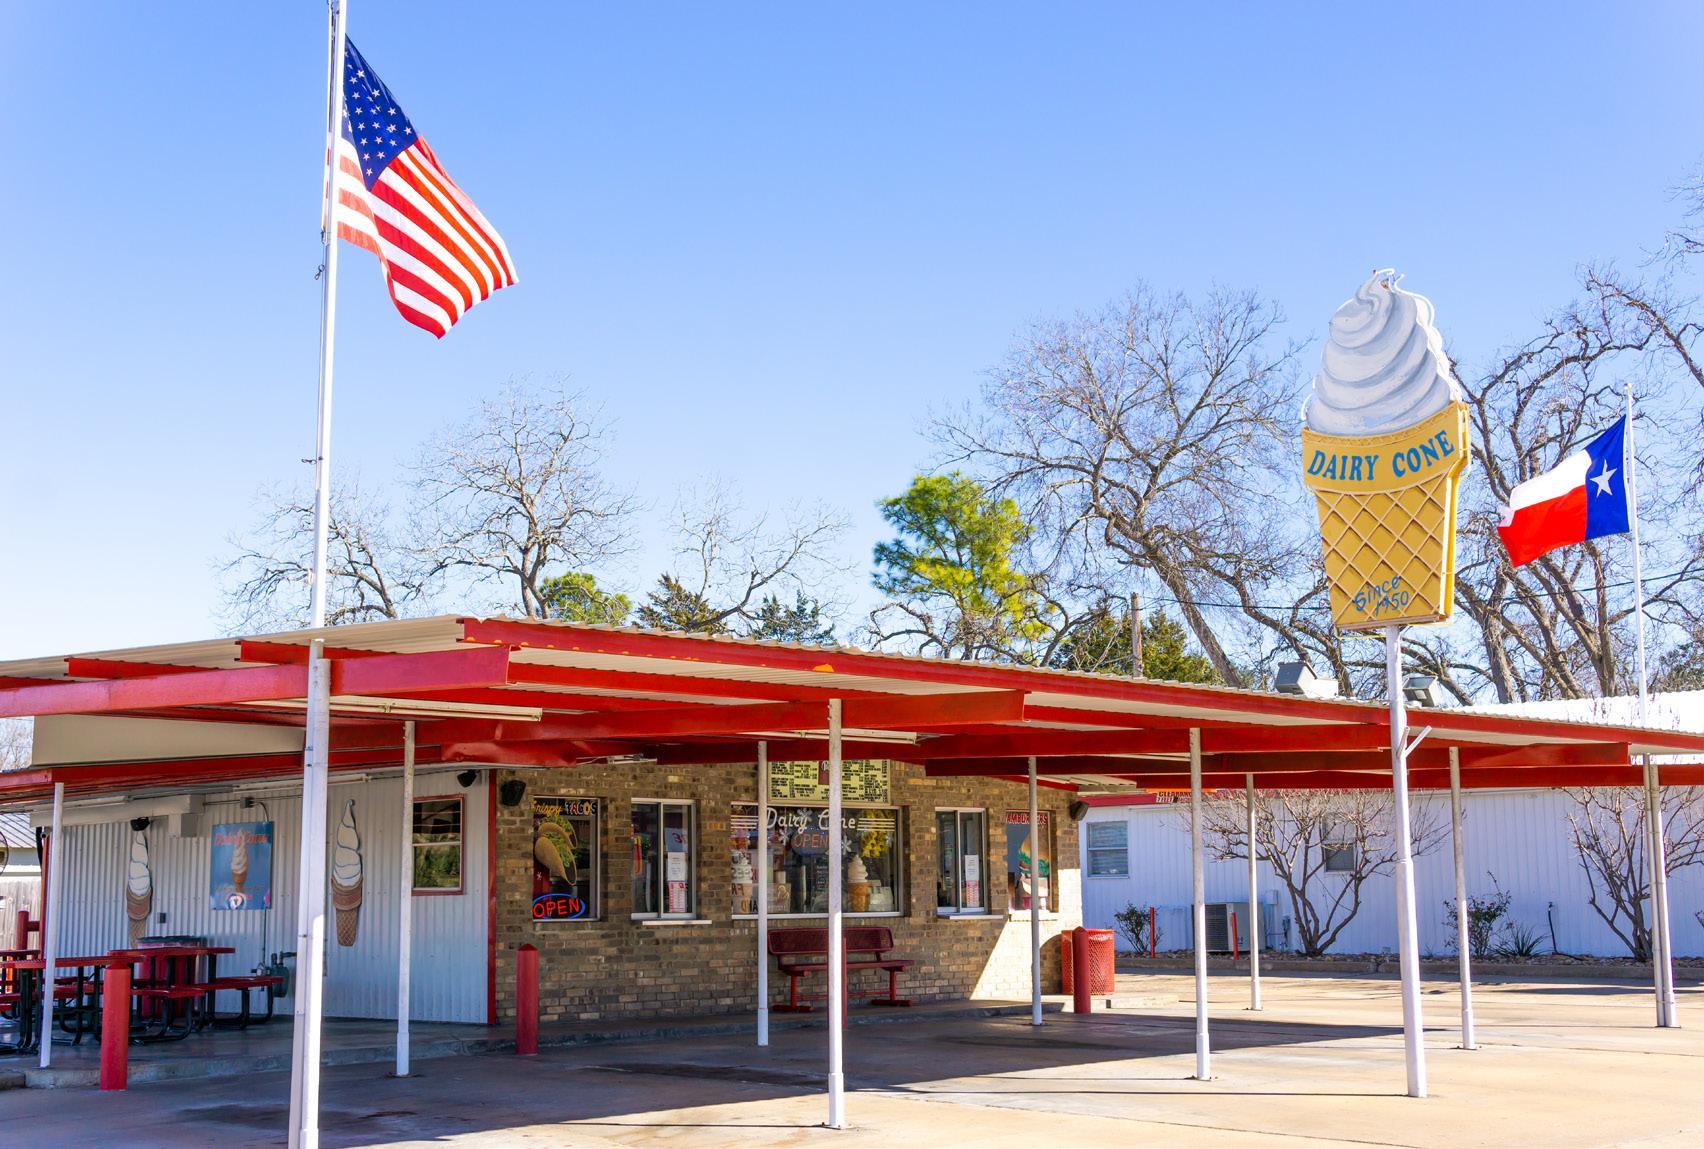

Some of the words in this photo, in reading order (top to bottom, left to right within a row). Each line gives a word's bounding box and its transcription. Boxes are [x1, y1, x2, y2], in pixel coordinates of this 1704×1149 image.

[1307, 450, 1379, 481] DAIRY
[1392, 430, 1455, 478] CONE
[1354, 576, 1400, 612] Since
[1375, 590, 1409, 617] 1950
[766, 807, 807, 834] Dairy
[817, 809, 856, 831] Cne
[793, 833, 829, 848] OPEN
[532, 898, 580, 918] OPEN
